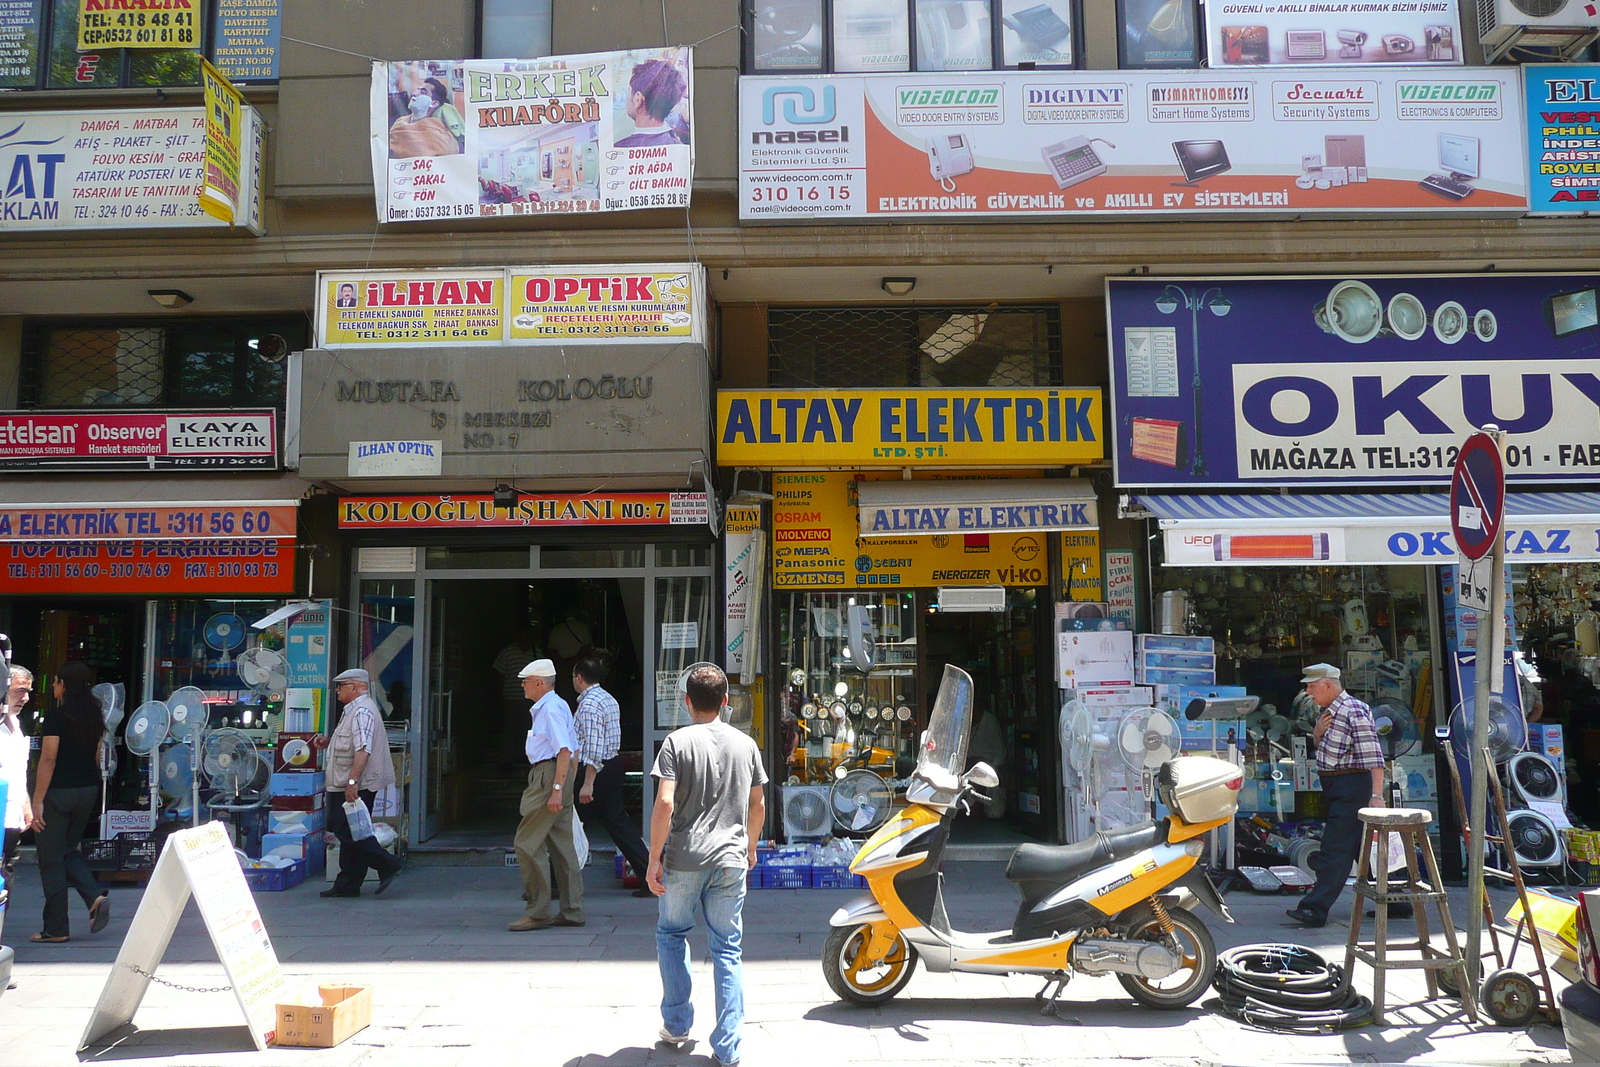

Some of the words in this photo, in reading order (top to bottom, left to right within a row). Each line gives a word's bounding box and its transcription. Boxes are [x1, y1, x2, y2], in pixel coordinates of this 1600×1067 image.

[249, 8, 278, 16] KESİM
[1222, 2, 1263, 13] GÜVENLİ
[1277, 4, 1306, 12] AKILLI
[1308, 2, 1348, 12] BİNALAR
[1350, 4, 1390, 12] KURMAK
[84, 14, 112, 27] TEL:
[117, 13, 146, 26] 418
[152, 13, 170, 26] 48
[175, 12, 192, 26] 41
[224, 18, 268, 26] DAVETİYE
[136, 29, 156, 42] 601
[160, 29, 173, 42] 81
[178, 29, 193, 42] 88
[224, 28, 270, 36] KARTVİZİT
[228, 38, 264, 46] MATBAA
[216, 48, 252, 56] BRANDA
[255, 48, 274, 56] AFİŞ
[236, 68, 250, 76] 324
[469, 64, 609, 103] ERKEK
[900, 89, 999, 106] VIDEOCOM
[1028, 88, 1124, 104] DIGIVINT
[1152, 87, 1248, 102] MYSMARTHOMESYS
[1287, 84, 1364, 100] Secuart
[1400, 85, 1496, 100] VIDEOCOM
[478, 98, 601, 128] KUAFÖRÜ
[900, 112, 921, 122] VIDEO
[922, 112, 942, 122] DOOR
[944, 112, 966, 122] ENTRY
[967, 112, 999, 122] SYSTEMS
[1152, 107, 1180, 119] Smart
[1183, 107, 1208, 118] Home
[1212, 107, 1250, 120] Systems
[1283, 106, 1326, 120] Security
[1328, 106, 1370, 119] Systems
[1401, 108, 1448, 116] ELECTRONICS
[1456, 107, 1498, 116] COMPUTERS
[80, 120, 120, 132] DAMGA
[133, 118, 178, 130] MATBAA
[1543, 124, 1600, 136] PHİL
[752, 126, 849, 144] nasel
[74, 136, 100, 151] AFİŞ
[113, 136, 152, 148] PLAKET
[628, 148, 667, 160] BOYAMA
[752, 148, 802, 156] Elektronik
[805, 147, 849, 156] Güvenlik
[92, 154, 125, 165] FOLYO
[129, 152, 164, 164] KESİM
[752, 157, 806, 166] Sistemleri
[412, 160, 433, 172] SAÇ
[647, 160, 672, 174] AĞDA
[76, 168, 126, 182] ATATÜRK
[128, 166, 176, 180] POSTERİ
[413, 174, 446, 186] SAKAL
[750, 173, 852, 184] www.videocom.com.tr
[630, 178, 648, 190] CİLT
[652, 178, 687, 188] BAKIMI
[72, 187, 122, 198] TASARIM
[124, 186, 138, 198] VE
[142, 186, 190, 197] TANITIM
[413, 188, 436, 201] FÖN
[752, 187, 788, 202] 310
[797, 186, 819, 200] 16
[828, 186, 850, 200] 15
[879, 193, 977, 210] ELEKTRONİK
[988, 192, 1065, 209] GÜVENLİK
[1075, 198, 1094, 208] ve
[1105, 194, 1152, 208] AKILLI
[1164, 193, 1184, 207] EV
[1194, 190, 1288, 206] SİSTEMLERİ
[100, 205, 117, 218] 324
[390, 204, 409, 218] Ömer
[750, 204, 852, 214] nasel@videocom.com.tr
[366, 280, 494, 306] İLHAN
[525, 276, 654, 303] OPTİK
[360, 308, 388, 318] EMEKLİ
[391, 308, 424, 318] SANDIĞI
[434, 309, 464, 317] MERKEZ
[466, 308, 498, 316] BANKASI
[522, 305, 539, 314] TÜM
[542, 305, 586, 313] BANKALAR
[602, 303, 628, 312] RESMİ
[630, 304, 686, 312] KURUMLARIN
[338, 322, 374, 330] TELEKOM
[378, 320, 410, 330] BAĞKUR
[434, 318, 460, 328] ZİRAAT
[466, 320, 498, 328] BANKASI
[546, 314, 613, 324] REÇETELERİ
[618, 314, 662, 322] YAPILIR
[568, 326, 600, 334] 0312
[336, 379, 460, 403] MUSTAFA
[518, 375, 653, 402] KOLOĞLU
[464, 409, 551, 428] MERKEZİ
[722, 398, 863, 444] ALTAY
[880, 391, 1096, 442] ELEKTRİK
[88, 424, 162, 441] Observer
[180, 422, 259, 433] KAYA
[172, 432, 266, 448] ELEKTRİK
[88, 444, 119, 454] Hareket
[120, 444, 161, 454] sensörleri
[358, 442, 394, 458] İLHAN
[398, 440, 434, 457] OPTİK
[873, 447, 910, 458] LTD.
[914, 444, 948, 459] ŞTİ.
[1251, 442, 1356, 470] MAĞAZA
[776, 475, 826, 484] SIEMENS
[776, 490, 812, 498] PHILIPS
[344, 496, 497, 523] KOLOĞLU
[622, 503, 650, 518] NO:
[19, 508, 118, 536] ELEKTRİK
[124, 512, 161, 534] TEL
[210, 512, 235, 534] 56
[242, 510, 270, 533] 60
[726, 510, 760, 522] ALTAY
[774, 512, 821, 523] OSRAM
[872, 508, 950, 531] ALTAY
[958, 503, 1090, 529] ELEKTRİK
[726, 524, 760, 532] Elektrik
[778, 530, 829, 540] MOLVENO
[1184, 536, 1212, 544] UFO
[1387, 530, 1571, 556] OKYAZ
[794, 547, 830, 556] MEPA
[776, 557, 845, 568] Panasonic
[874, 558, 912, 568] SEBAT
[1110, 556, 1130, 564] ÜTÜ
[110, 564, 134, 577] 310
[218, 562, 242, 577] 310
[932, 570, 990, 580] ENERGIZER
[996, 565, 1042, 582] Vİ-KO
[777, 572, 843, 584] ÖZMEN85
[857, 574, 900, 584] emas
[1109, 574, 1132, 588] OCAK
